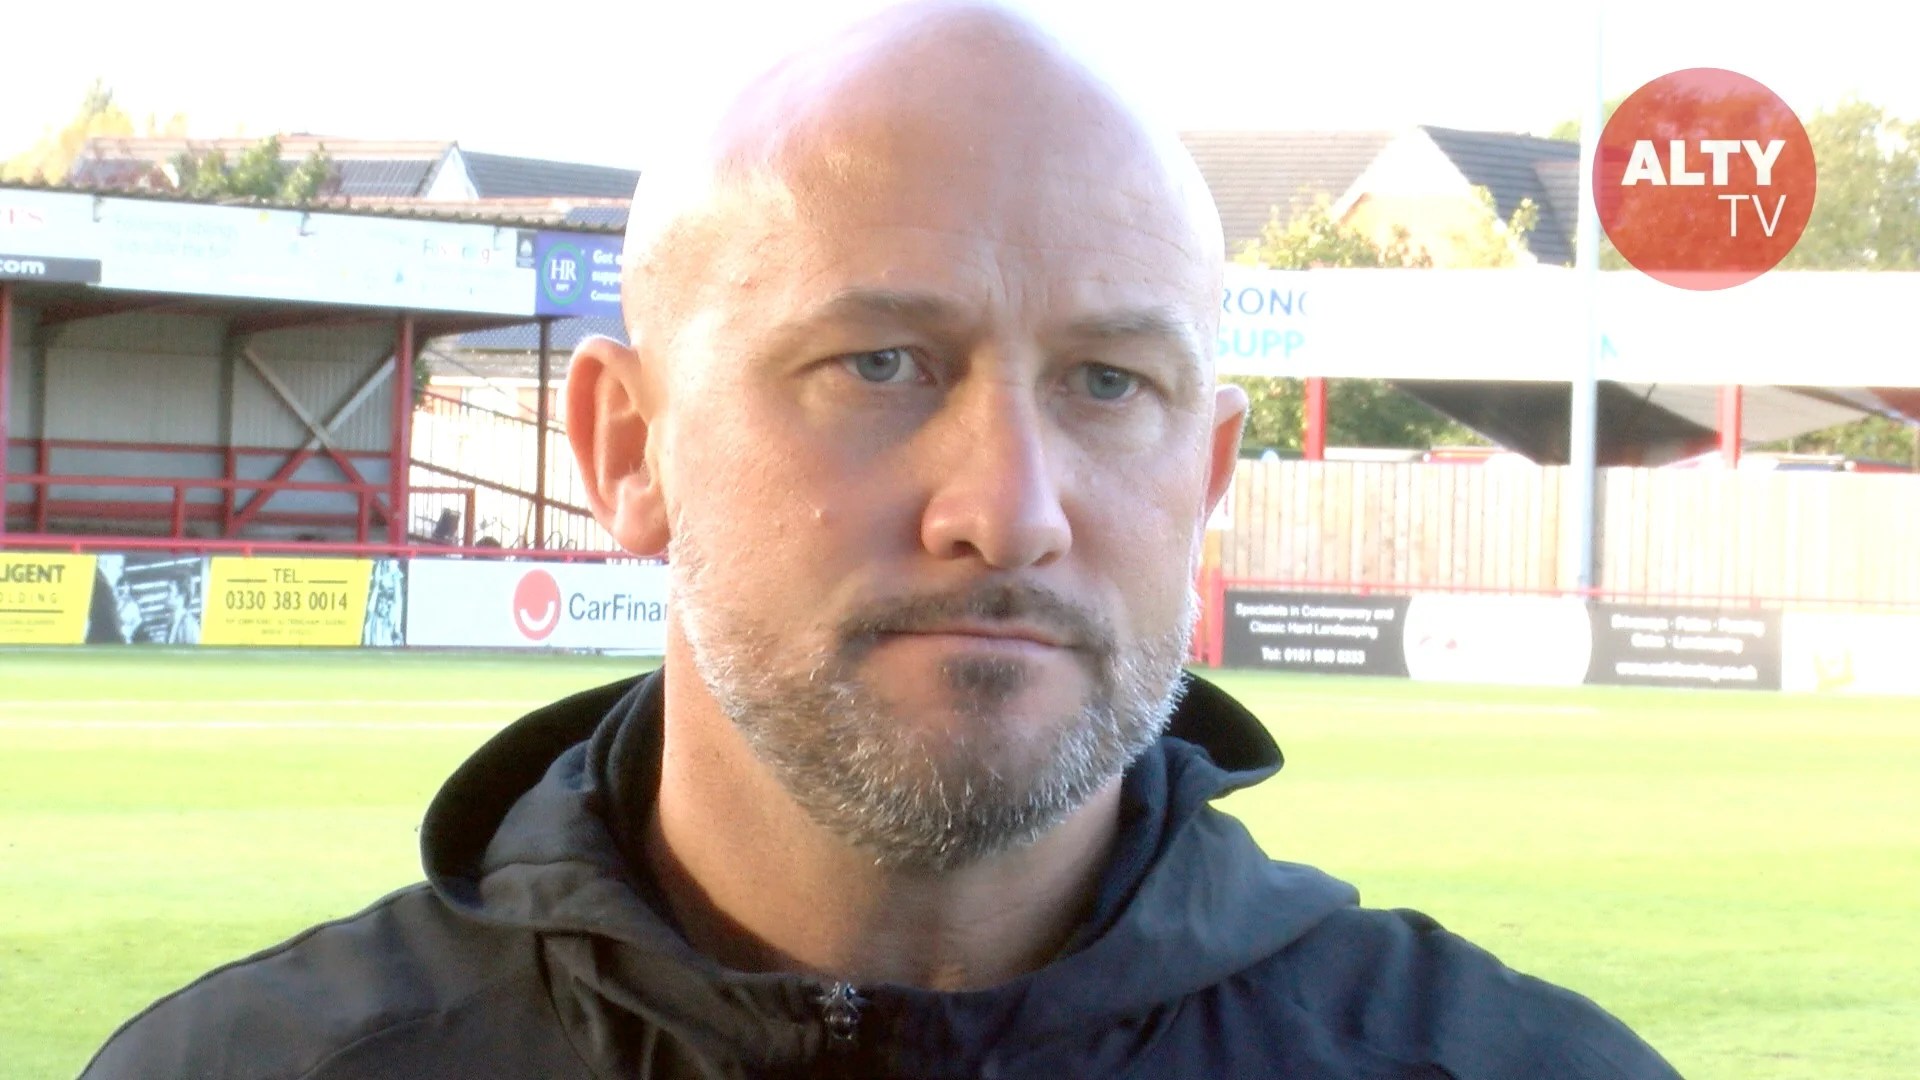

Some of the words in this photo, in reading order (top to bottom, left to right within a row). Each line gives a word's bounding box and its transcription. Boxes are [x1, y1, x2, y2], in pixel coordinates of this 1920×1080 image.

[0, 259, 45, 275] om
[550, 259, 577, 281] HR
[225, 590, 266, 610] 0330
[272, 590, 302, 611] 383
[308, 591, 348, 612] 0014
